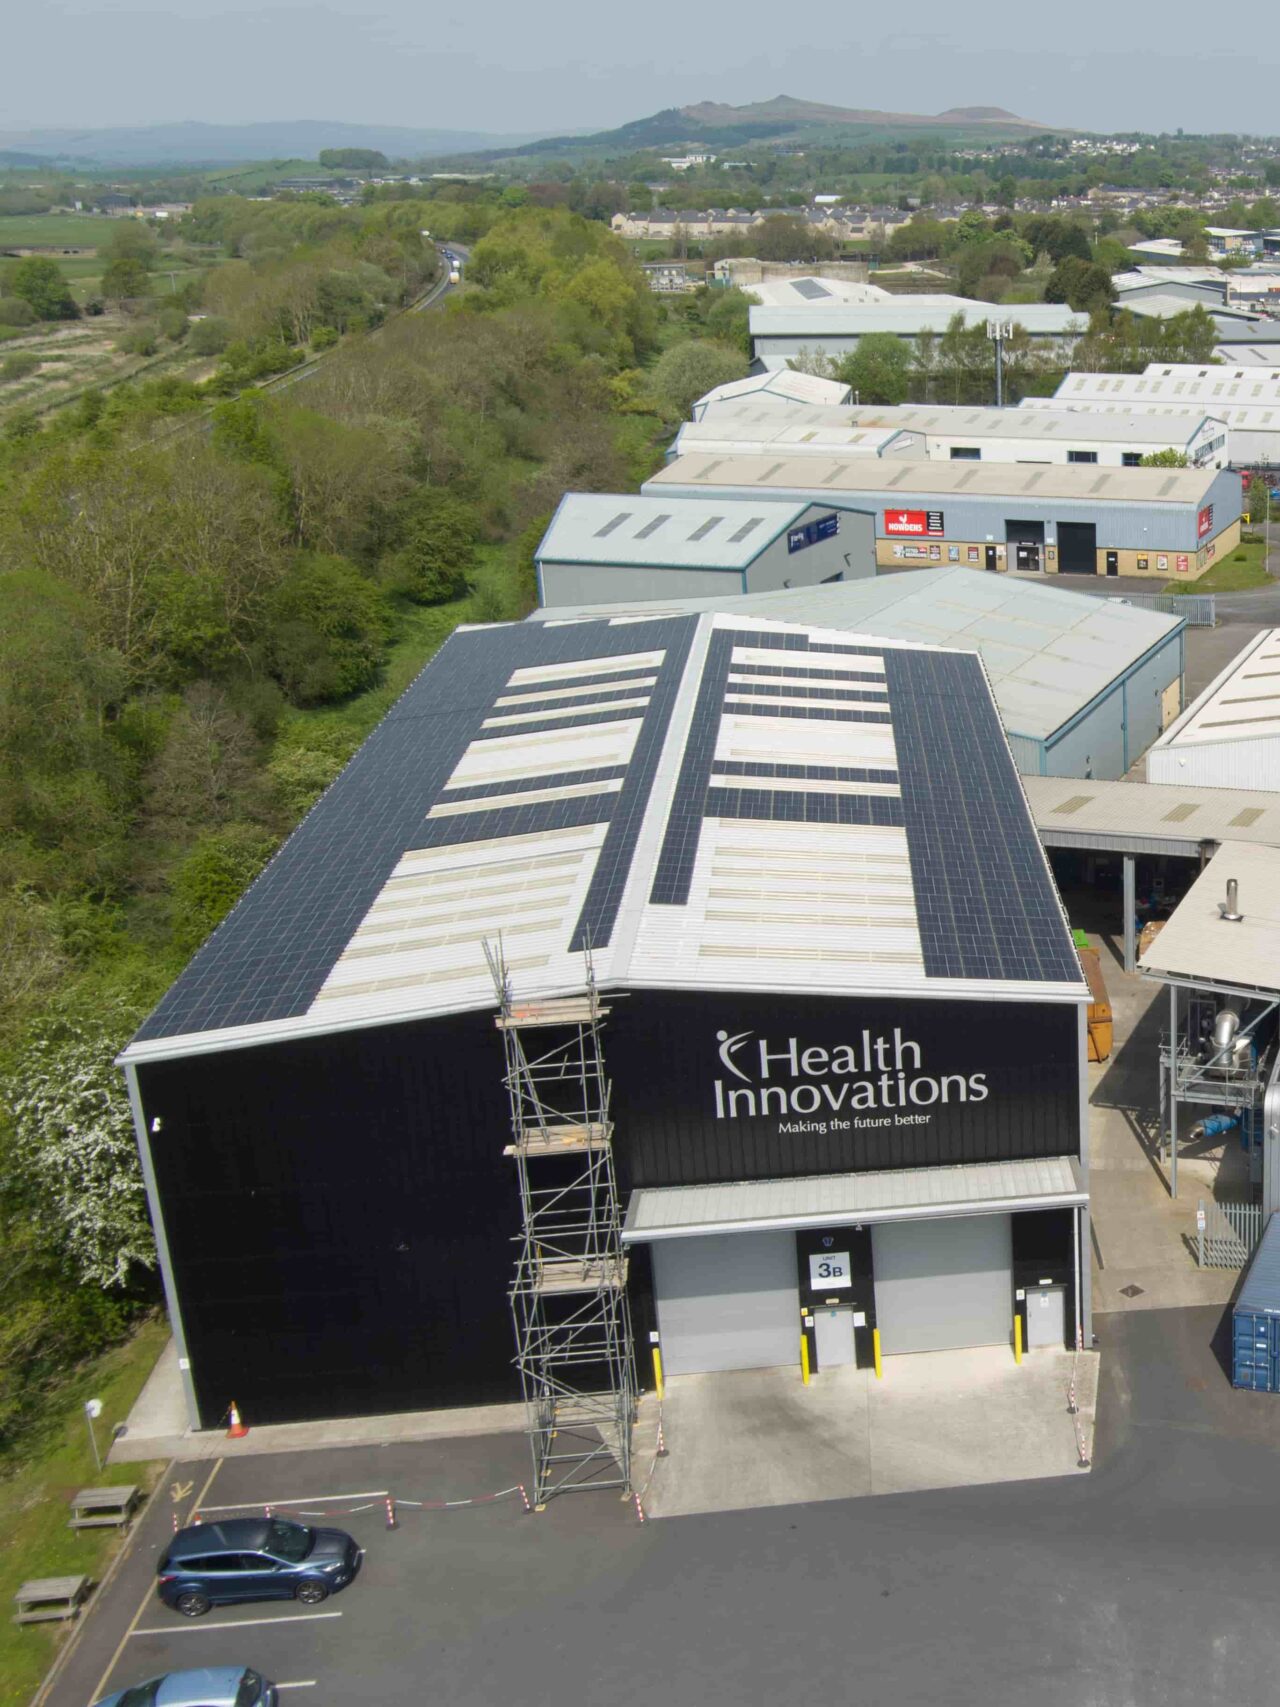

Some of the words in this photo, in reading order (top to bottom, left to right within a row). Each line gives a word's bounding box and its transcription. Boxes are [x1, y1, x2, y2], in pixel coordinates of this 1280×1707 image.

[888, 523, 923, 531] HOWDENS
[758, 1028, 921, 1078] Health
[714, 1071, 988, 1119] Innovations
[778, 1120, 827, 1135] Making
[830, 1117, 850, 1131] the
[854, 1115, 891, 1129] future
[895, 1112, 931, 1126] better
[818, 1263, 843, 1278] 3B
